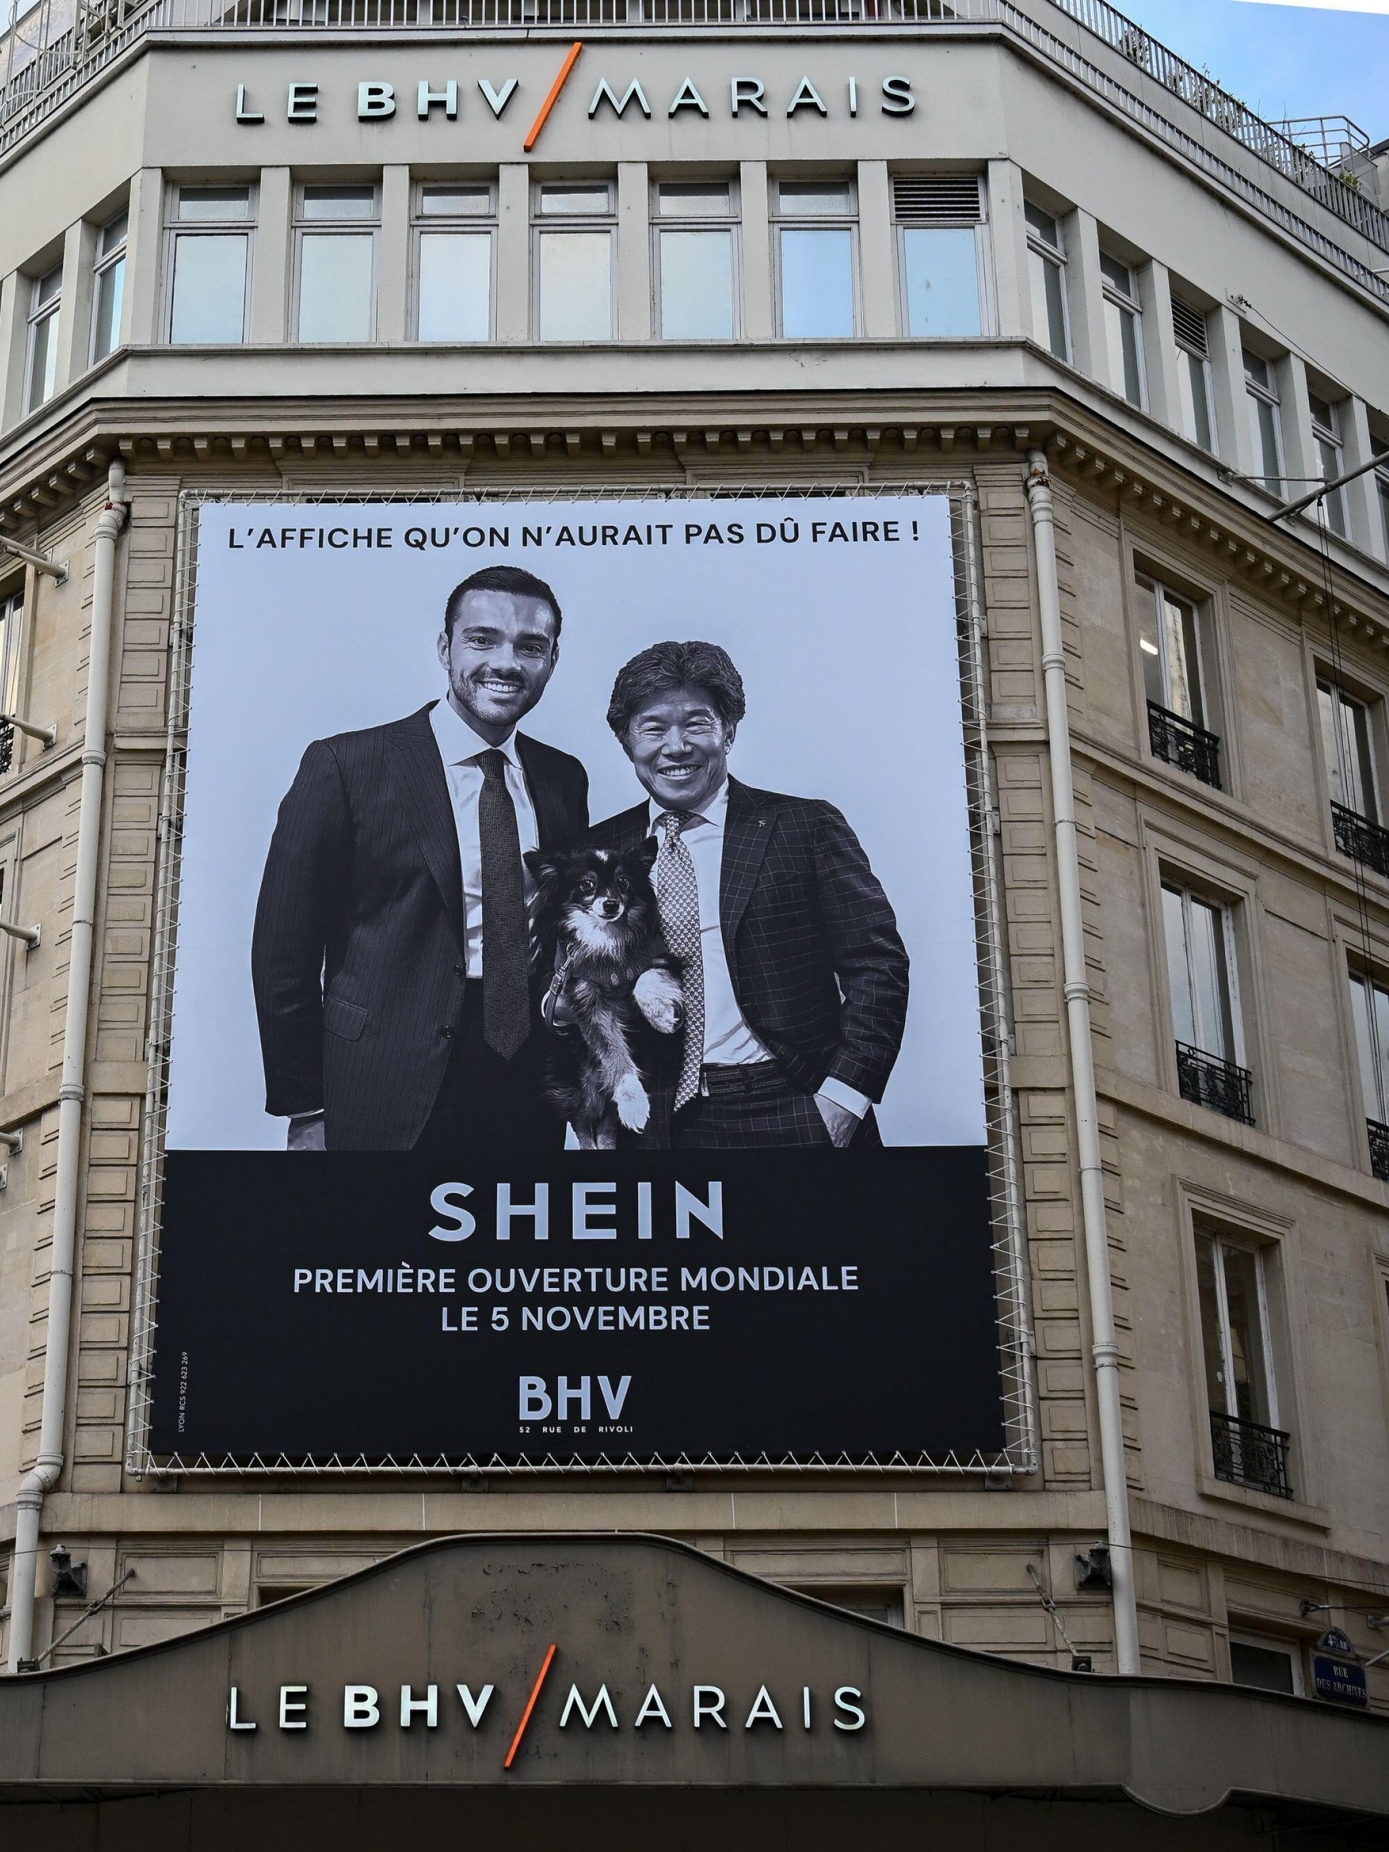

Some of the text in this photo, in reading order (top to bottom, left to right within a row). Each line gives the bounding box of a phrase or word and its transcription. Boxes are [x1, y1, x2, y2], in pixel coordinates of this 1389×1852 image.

[236, 83, 318, 123] LE
[358, 79, 519, 121] BHV
[588, 75, 915, 119] MARAIS
[228, 527, 393, 550] L'AFFICHE
[404, 526, 509, 551] QU'ON
[522, 524, 674, 548] N'AURAIT
[685, 523, 745, 545] PAS
[756, 516, 799, 544] DÛ
[811, 521, 900, 544] FAIRE
[428, 1180, 724, 1242] SHEIN
[293, 1261, 859, 1293] PREMIÈRE OUVERTURE MONDIALE
[442, 1305, 710, 1332] LE 5 NOVEMBRE
[180, 1366, 188, 1380] 623
[519, 1375, 632, 1420] BHV
[598, 1425, 633, 1433] RIVOLI
[1316, 1677, 1367, 1699] DES ARCHIVES
[1333, 1665, 1349, 1679] RUE
[230, 1685, 308, 1729] LE
[343, 1684, 495, 1728] BHV
[559, 1683, 866, 1730] MARAIS
